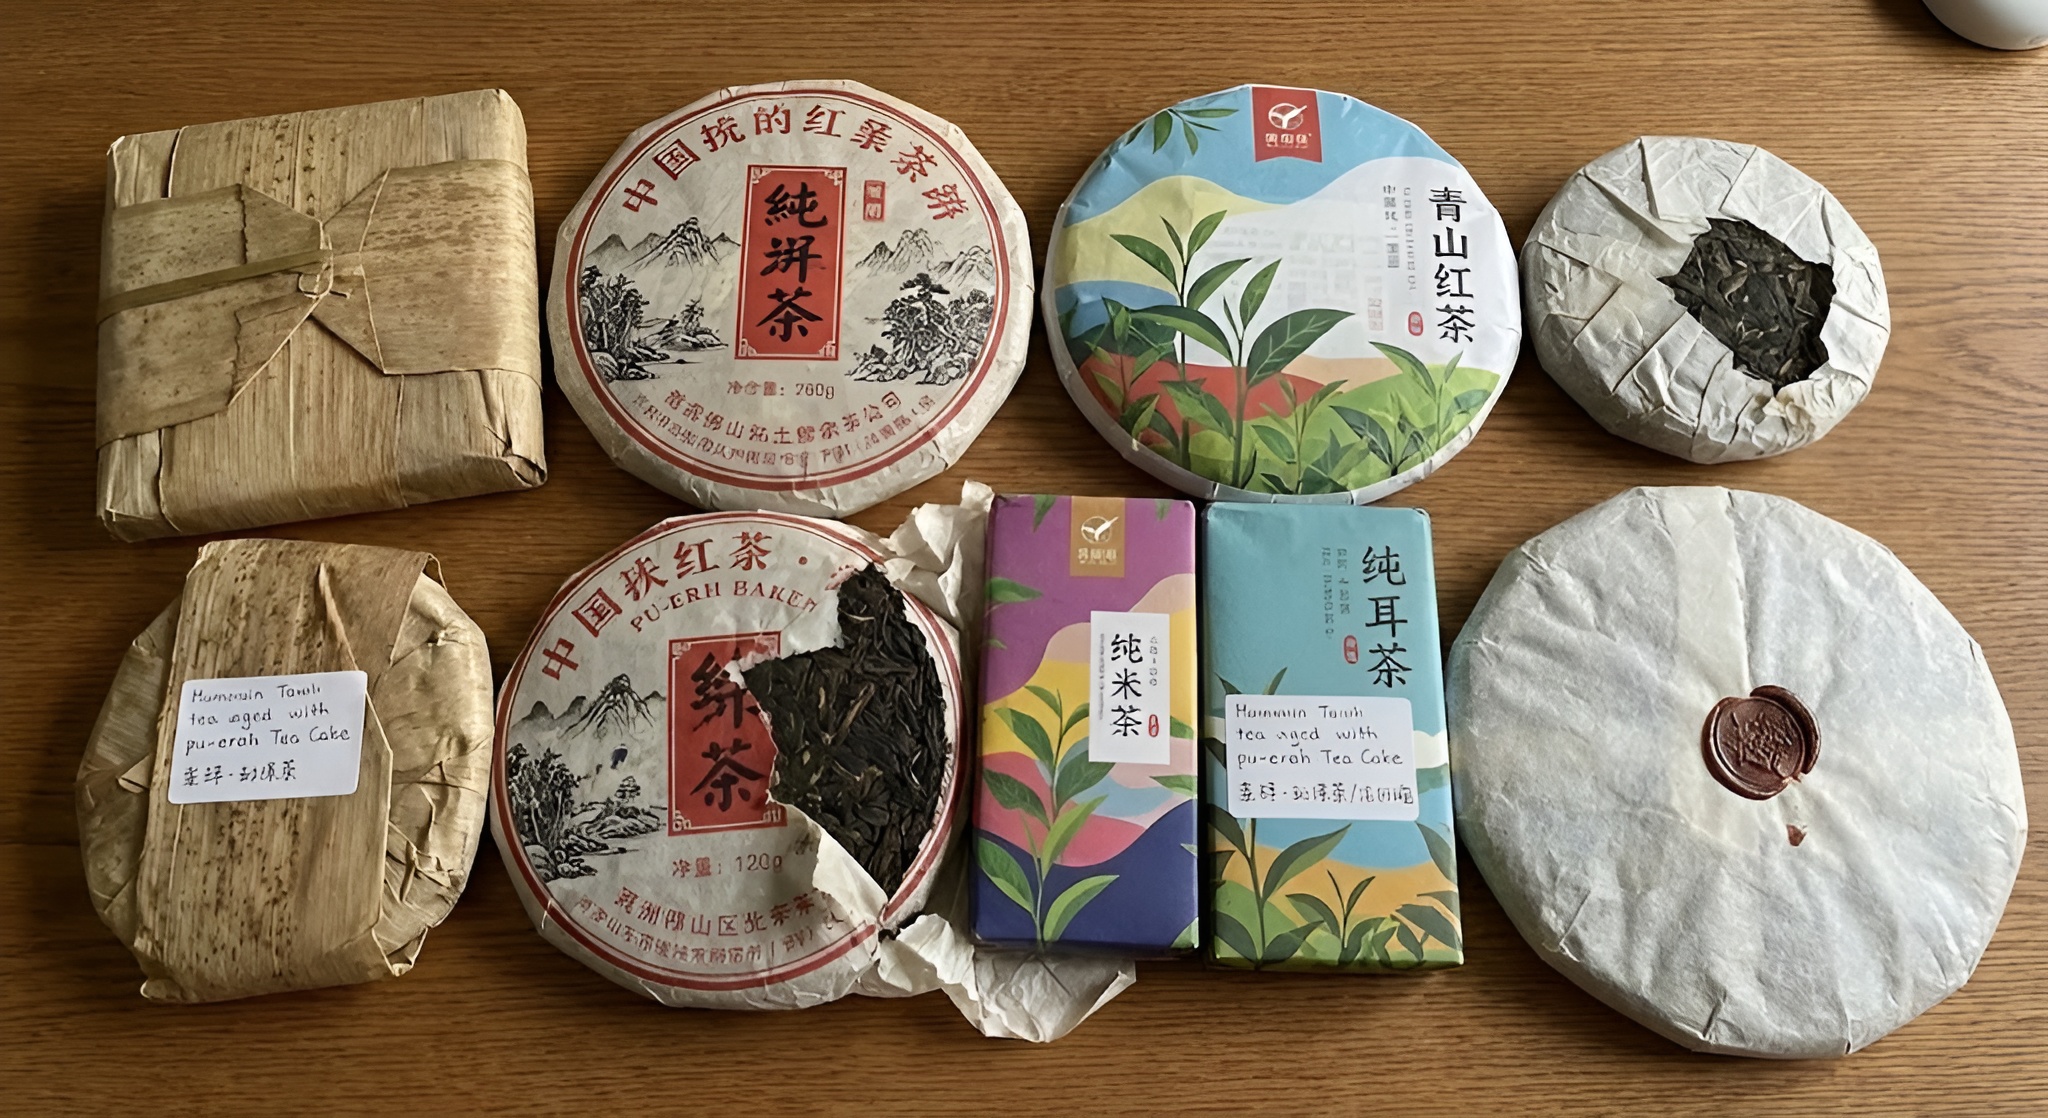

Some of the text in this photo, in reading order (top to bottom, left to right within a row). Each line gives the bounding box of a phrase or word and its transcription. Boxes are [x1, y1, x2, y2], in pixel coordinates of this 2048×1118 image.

[1429, 187, 1476, 343] 青山红茶
[1362, 546, 1412, 688] 纯耳茶
[1110, 633, 1144, 737] 纯米茶
[1320, 749, 1353, 765] Tea
[1361, 749, 1404, 765] Cake
